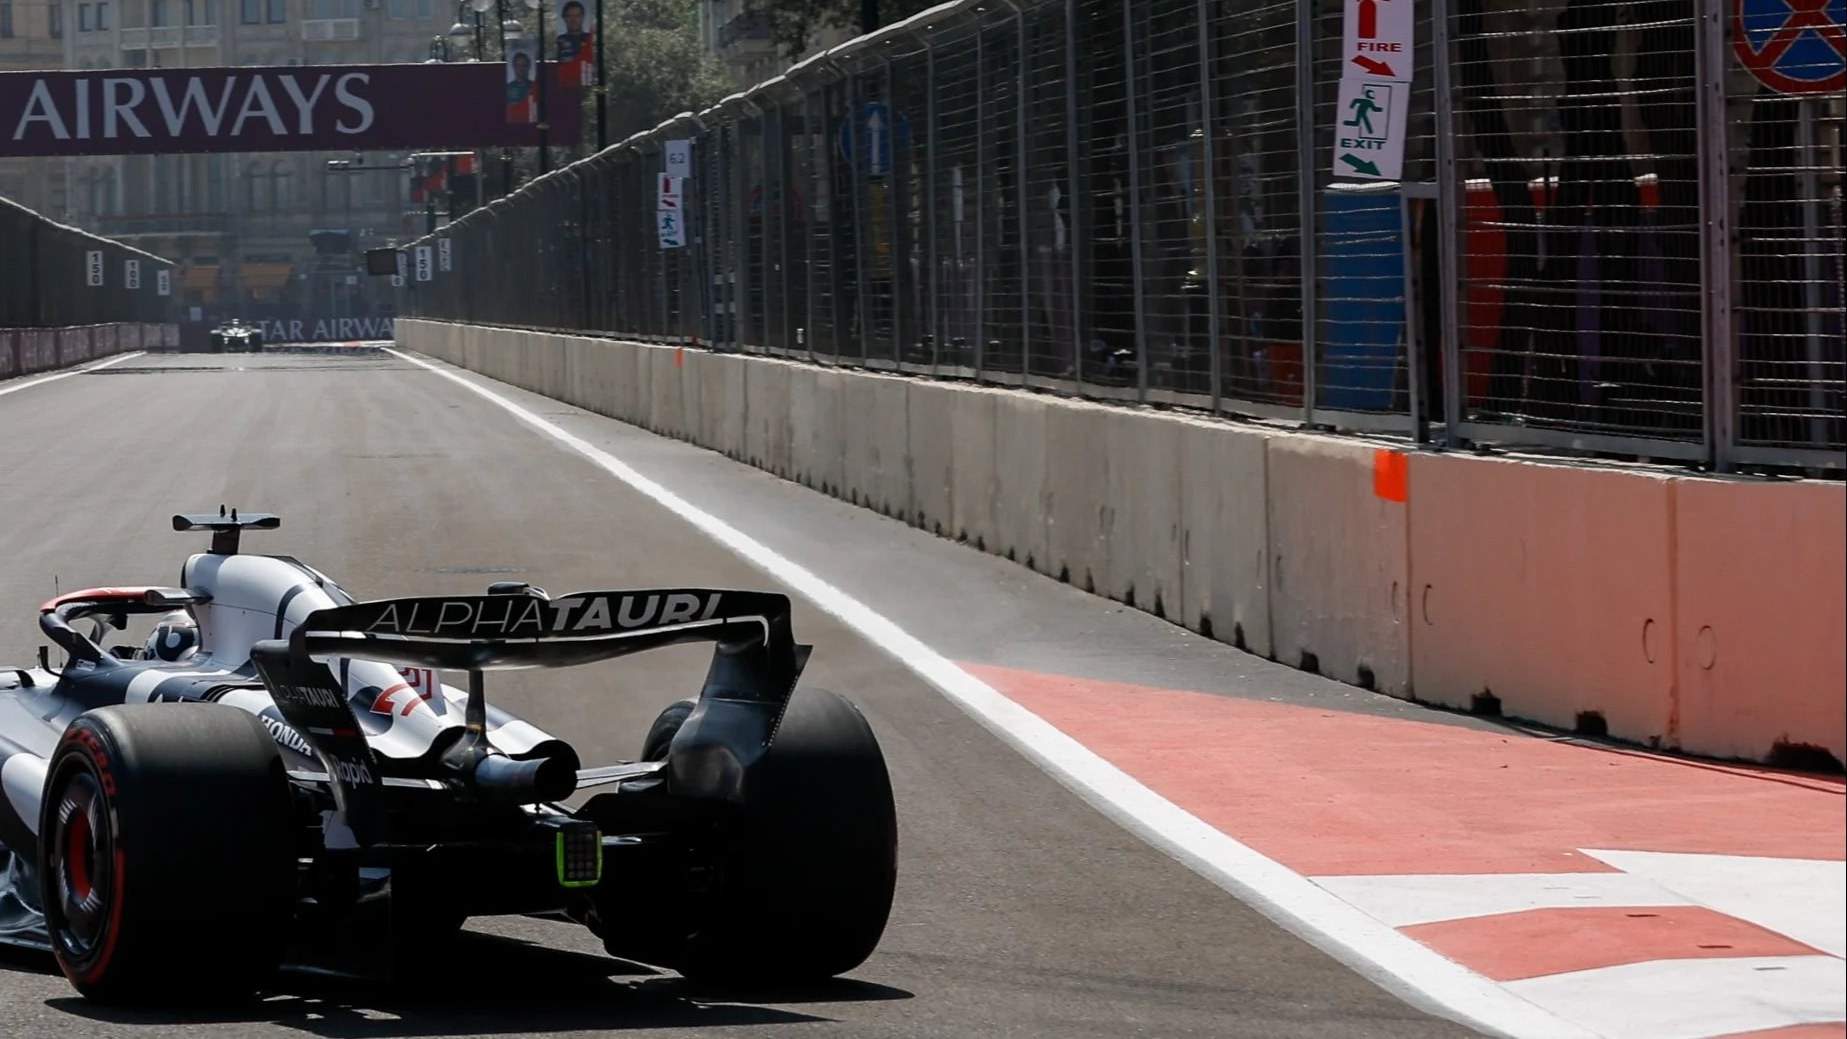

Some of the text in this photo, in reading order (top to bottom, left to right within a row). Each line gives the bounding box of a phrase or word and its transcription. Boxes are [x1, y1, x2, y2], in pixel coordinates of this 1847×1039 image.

[1357, 42, 1401, 53] FIRE
[13, 73, 376, 140] AIRWAYS
[1340, 138, 1385, 150] EXIT
[92, 253, 100, 284] 150
[419, 249, 428, 279] 150
[258, 317, 393, 340] TAR AIRWA
[366, 593, 723, 633] ALPHATAURI
